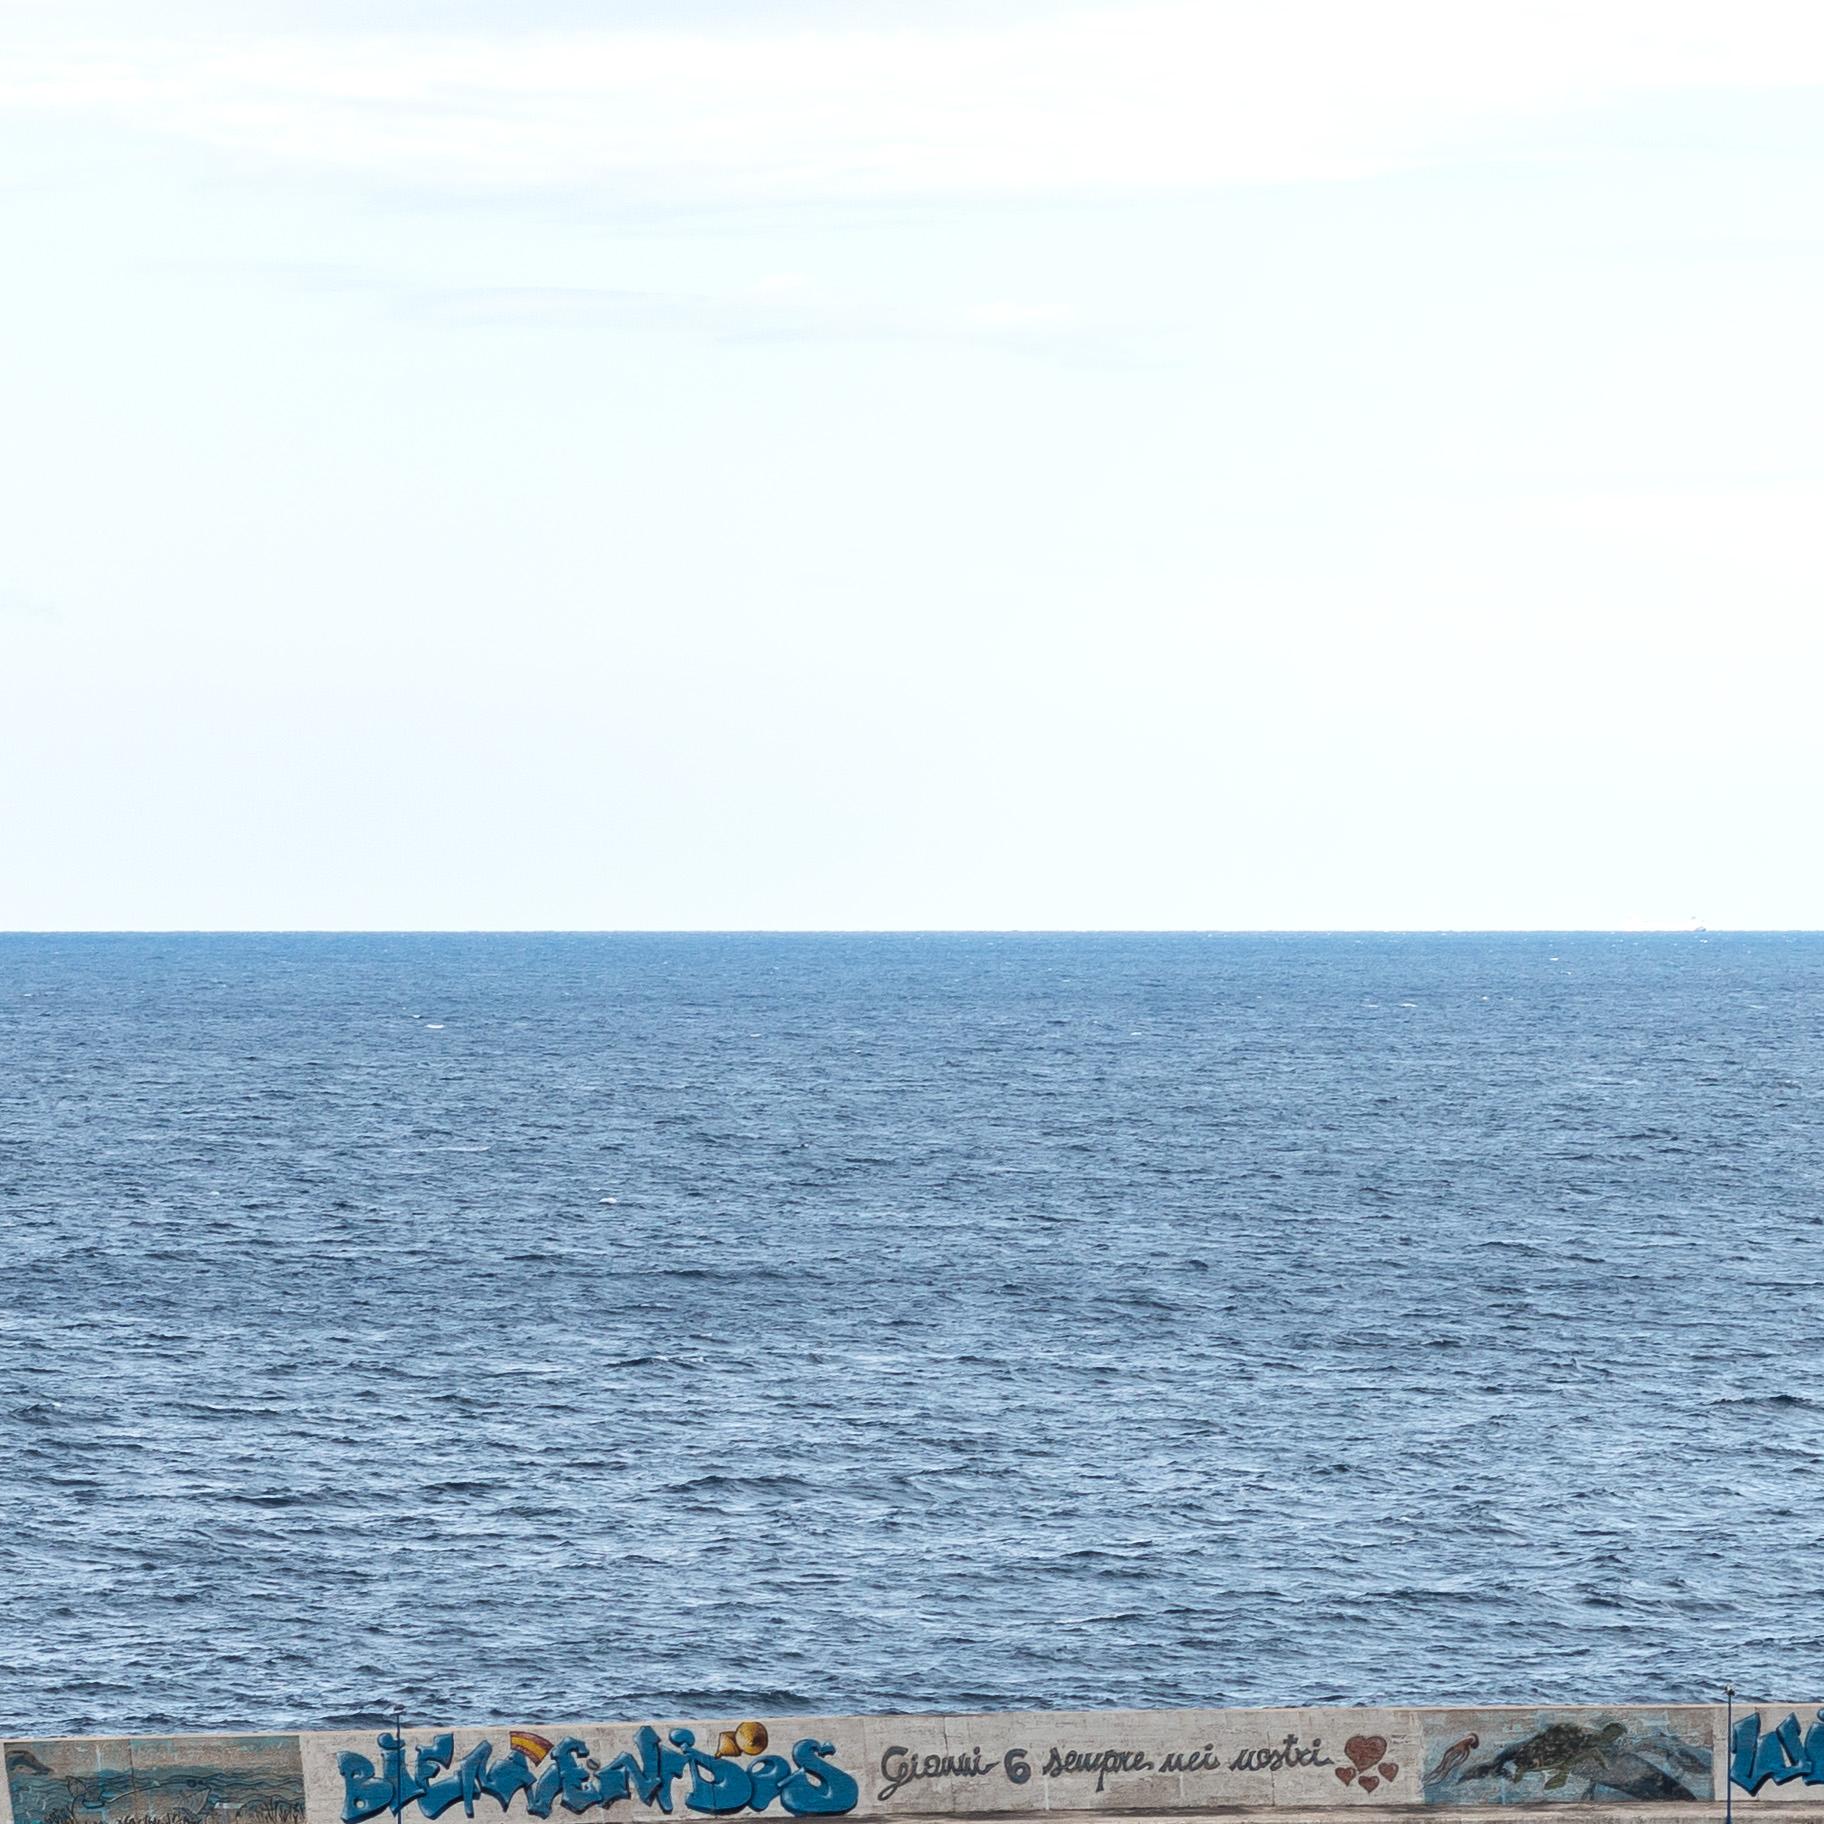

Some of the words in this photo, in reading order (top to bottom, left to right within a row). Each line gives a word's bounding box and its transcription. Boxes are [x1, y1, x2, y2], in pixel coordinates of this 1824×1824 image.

[1003, 1748, 1032, 1785] 6
[1042, 1747, 1155, 1793] sempre
[1158, 1743, 1221, 1774] nei
[1228, 1733, 1335, 1773] nostri
